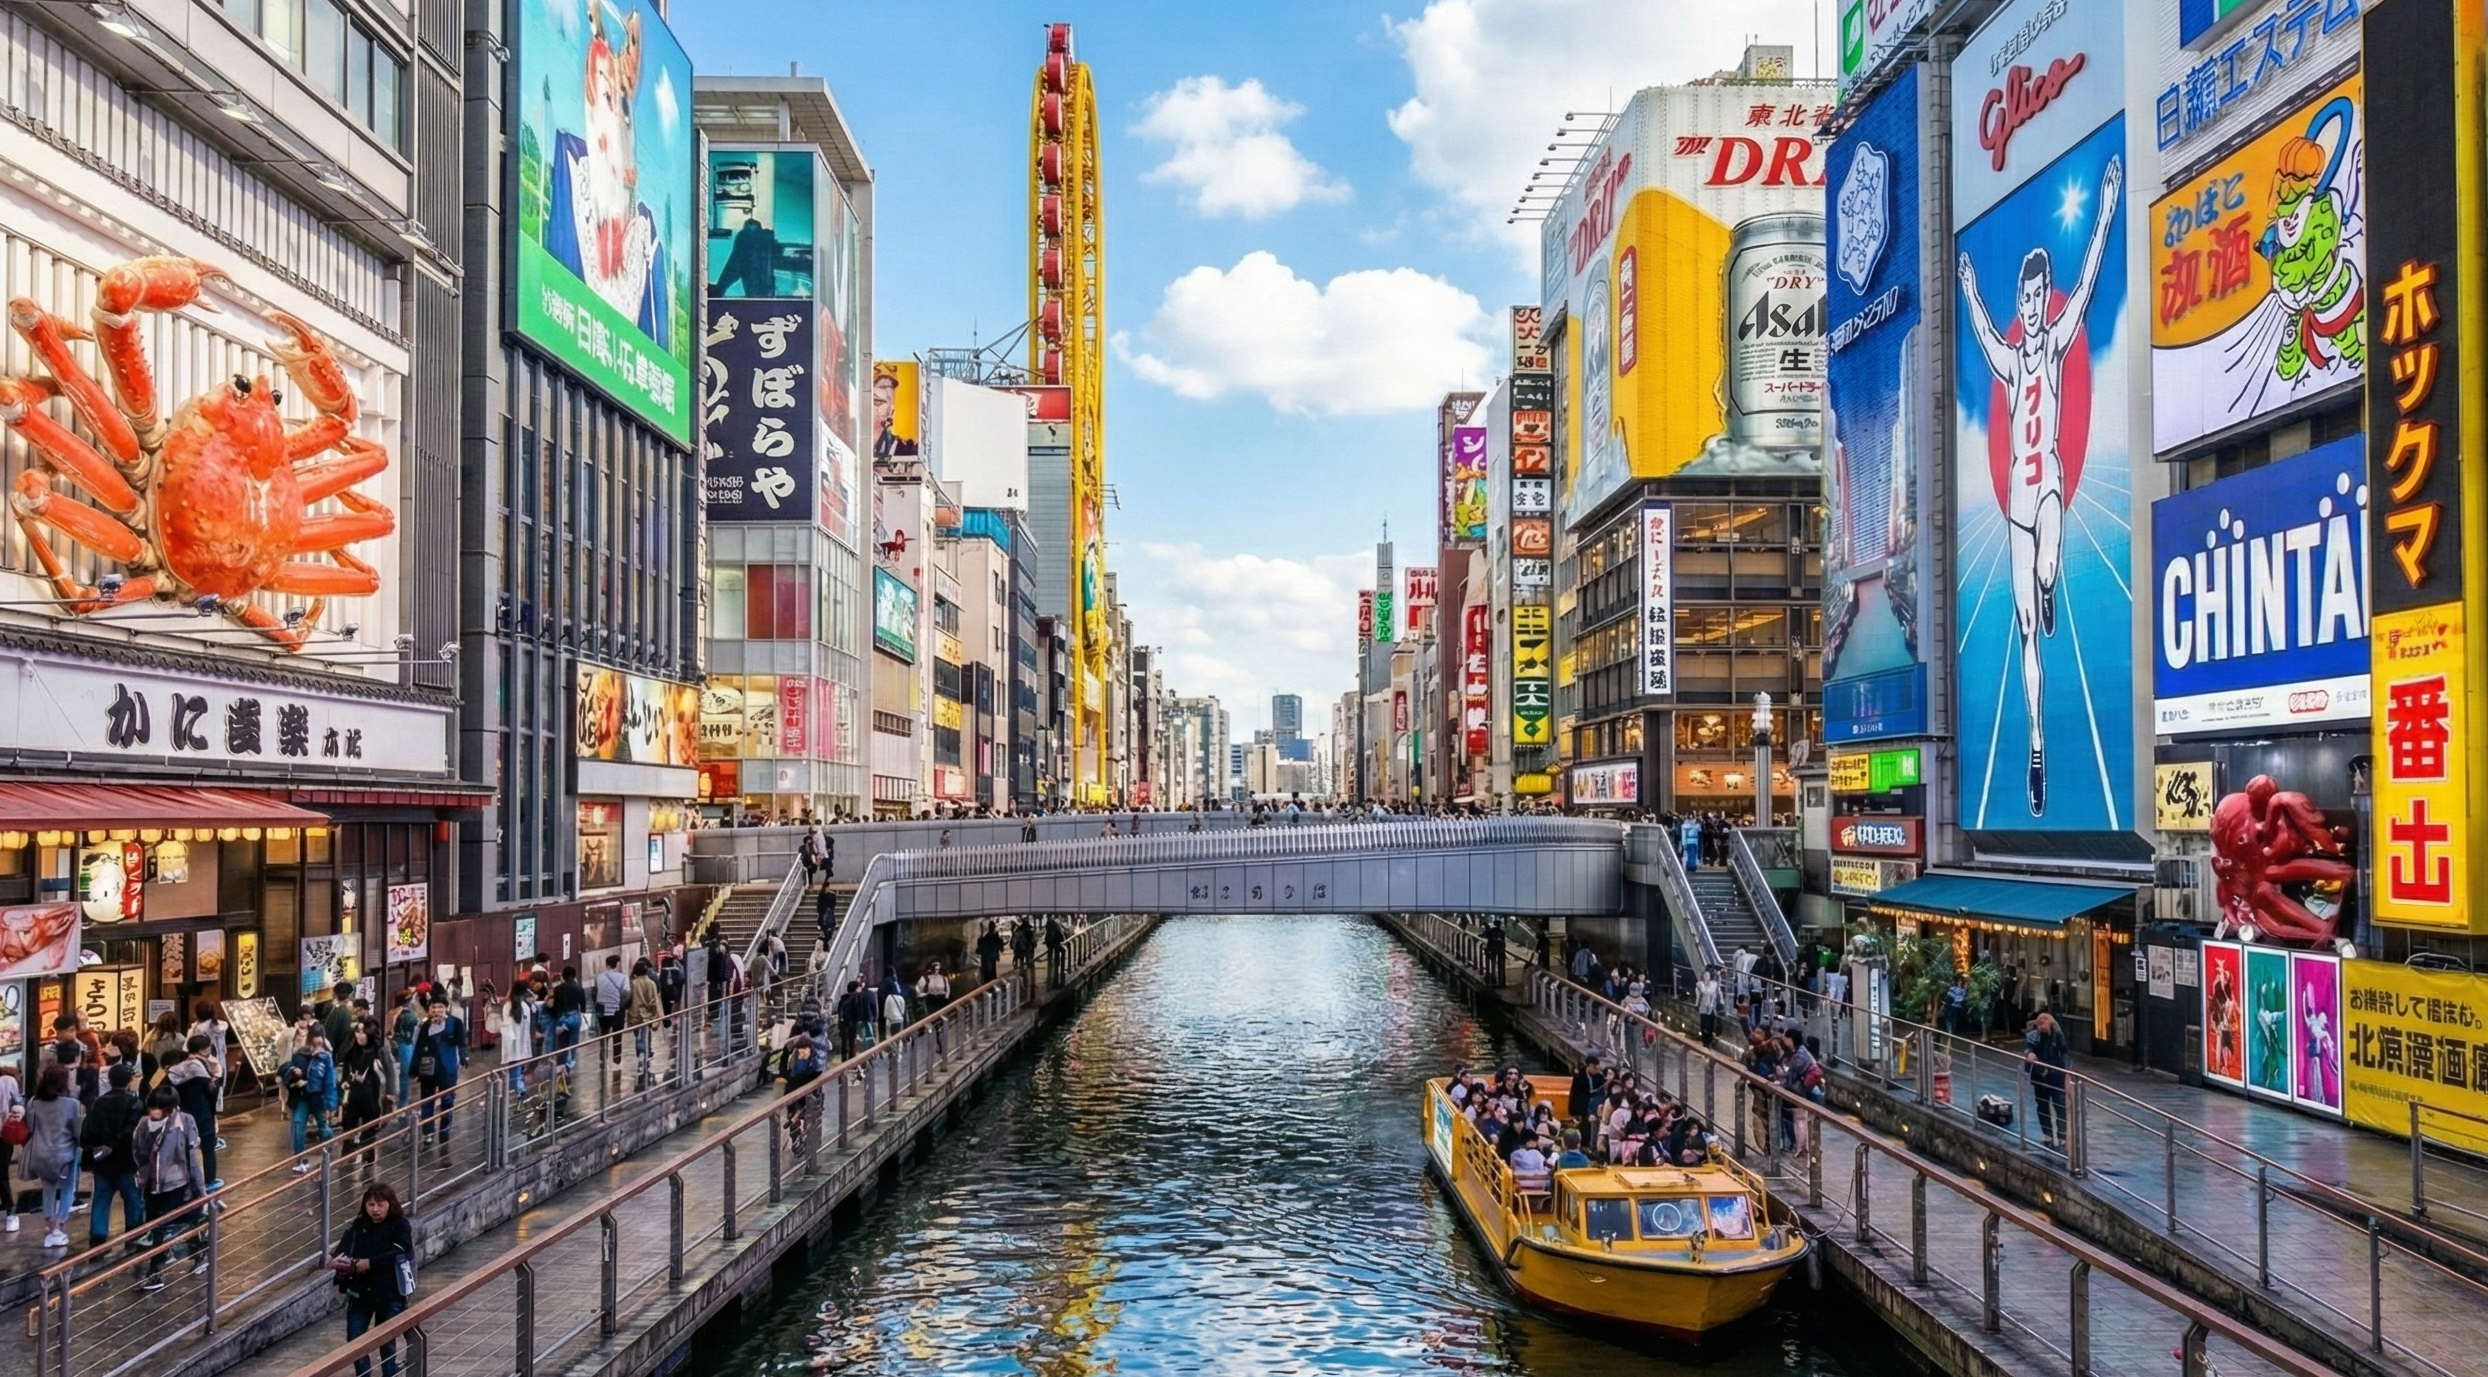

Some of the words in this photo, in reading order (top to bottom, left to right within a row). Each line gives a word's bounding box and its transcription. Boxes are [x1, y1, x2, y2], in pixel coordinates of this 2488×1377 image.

[1703, 136, 1826, 186] DR
[1979, 53, 2085, 172] Glico
[751, 314, 805, 510] ずぼらや
[1779, 349, 1812, 371] 生
[2381, 259, 2442, 588] ホックマ
